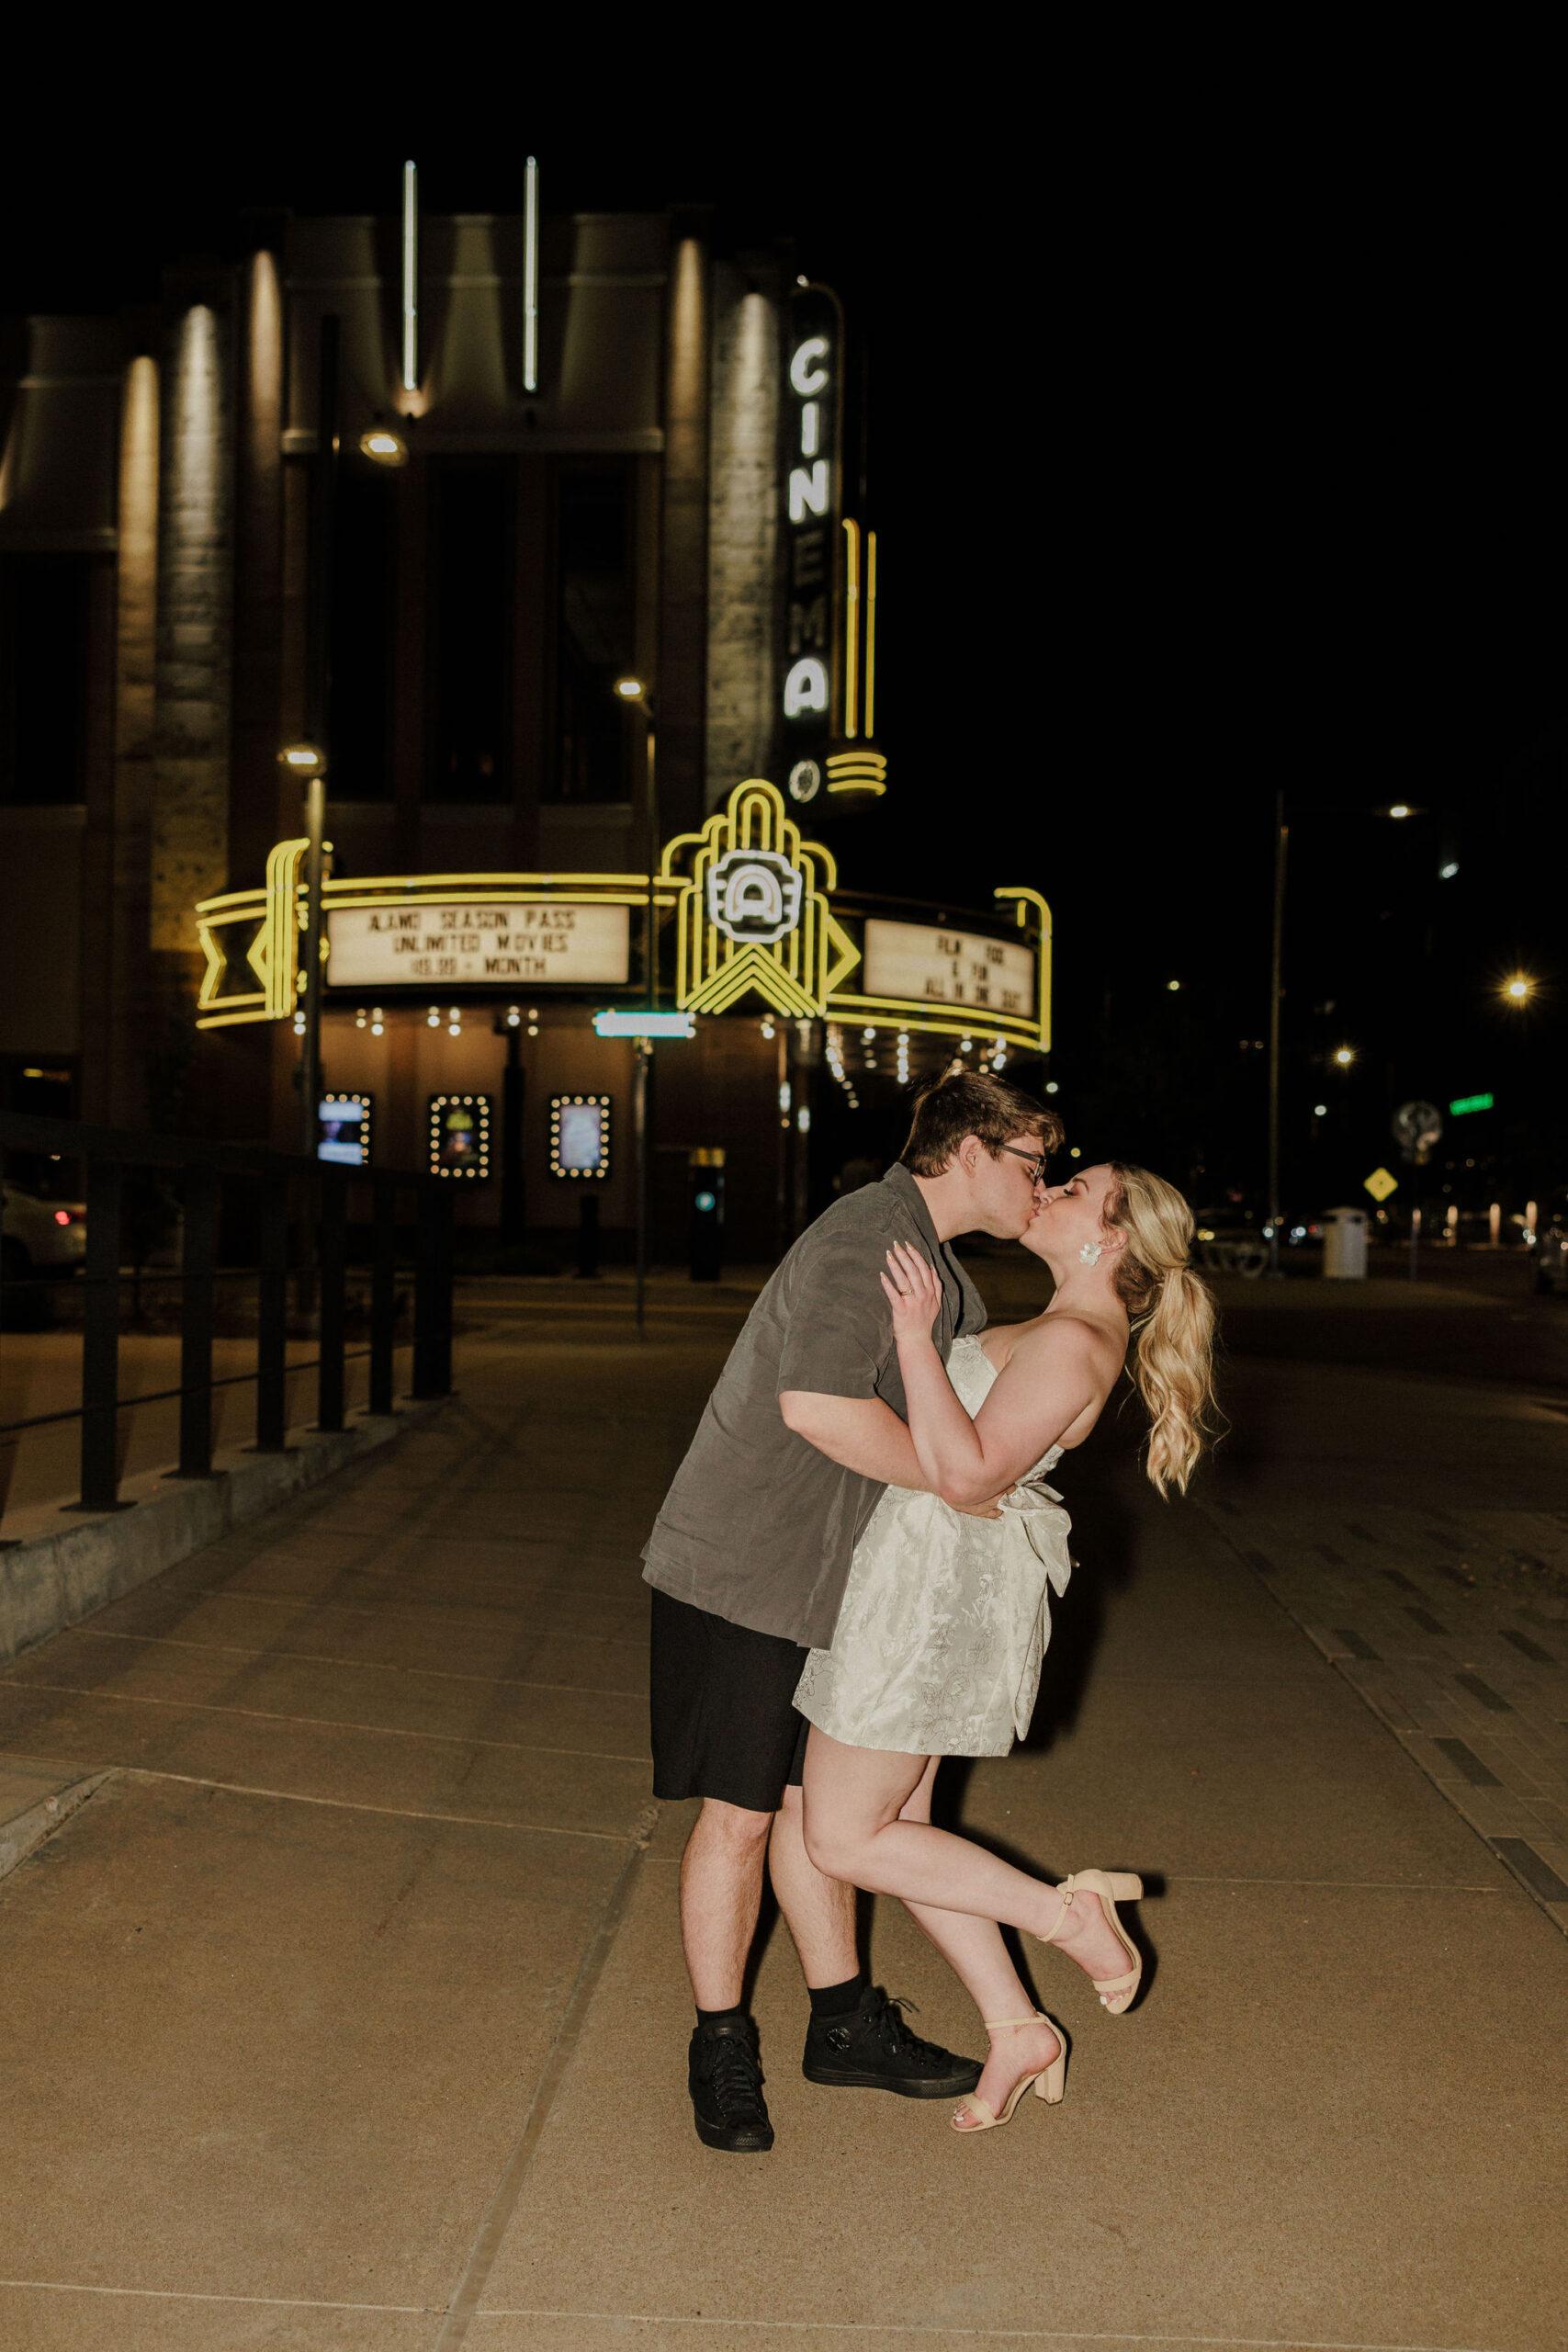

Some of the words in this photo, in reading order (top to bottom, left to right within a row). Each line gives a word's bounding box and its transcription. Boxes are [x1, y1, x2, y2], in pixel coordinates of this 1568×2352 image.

[784, 337, 829, 718] CINEMA
[441, 910, 508, 930] SEASON
[525, 909, 575, 930] PASS
[393, 934, 479, 953] UNLIMITED
[485, 956, 547, 975] MONTH
